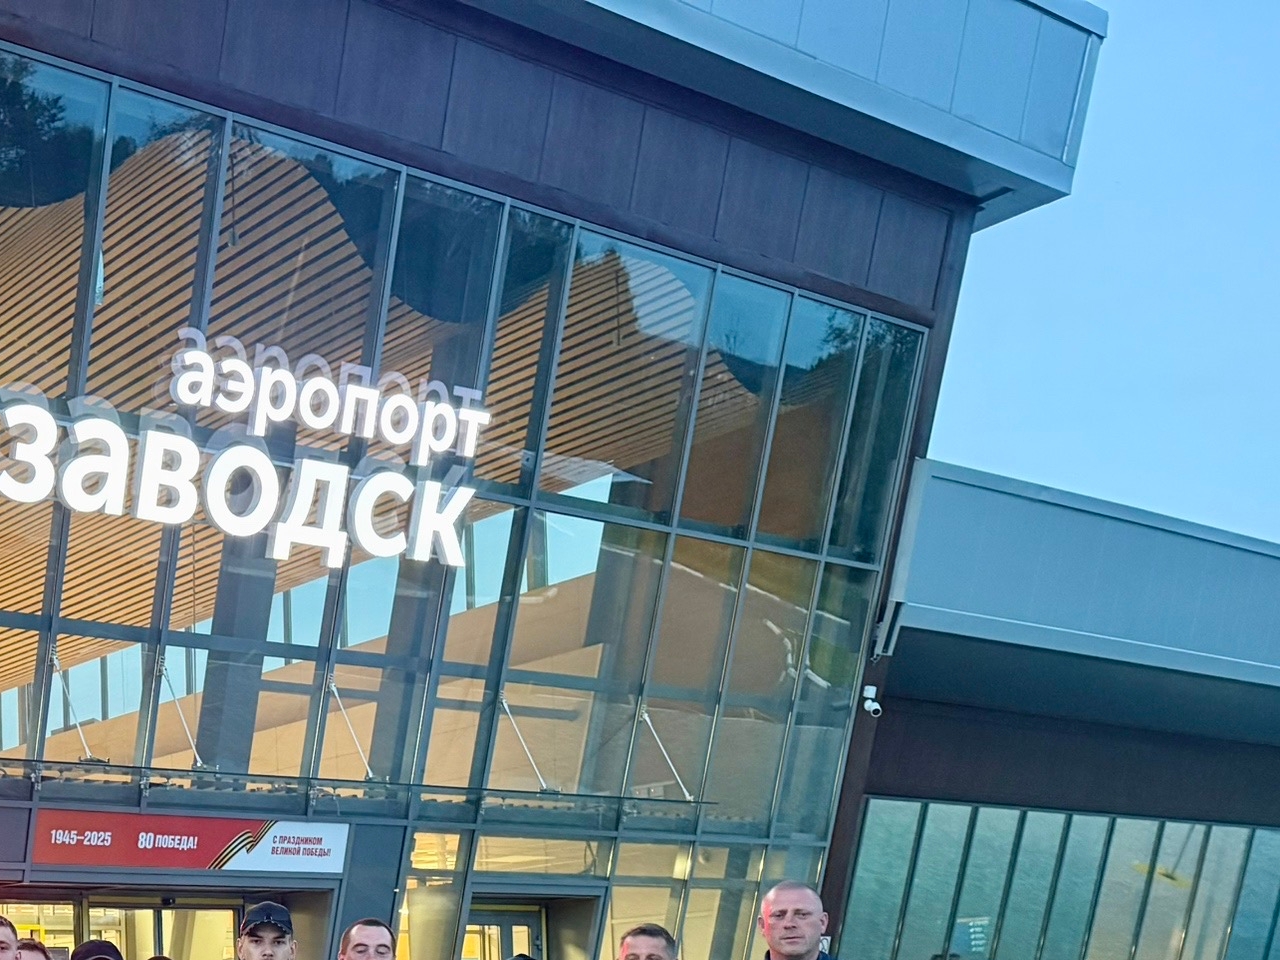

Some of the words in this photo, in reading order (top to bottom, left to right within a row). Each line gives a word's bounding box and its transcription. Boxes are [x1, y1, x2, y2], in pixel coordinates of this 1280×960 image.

[176, 350, 492, 466] аэропорт
[138, 832, 154, 849] 80
[155, 834, 198, 850] ПОБЕДА!
[272, 835, 278, 844] С
[278, 835, 323, 846] ПРАЗДНИКОМ
[271, 846, 301, 856] ВЕЛИКОЙ
[301, 847, 332, 857] ПОБЕДЫ!
